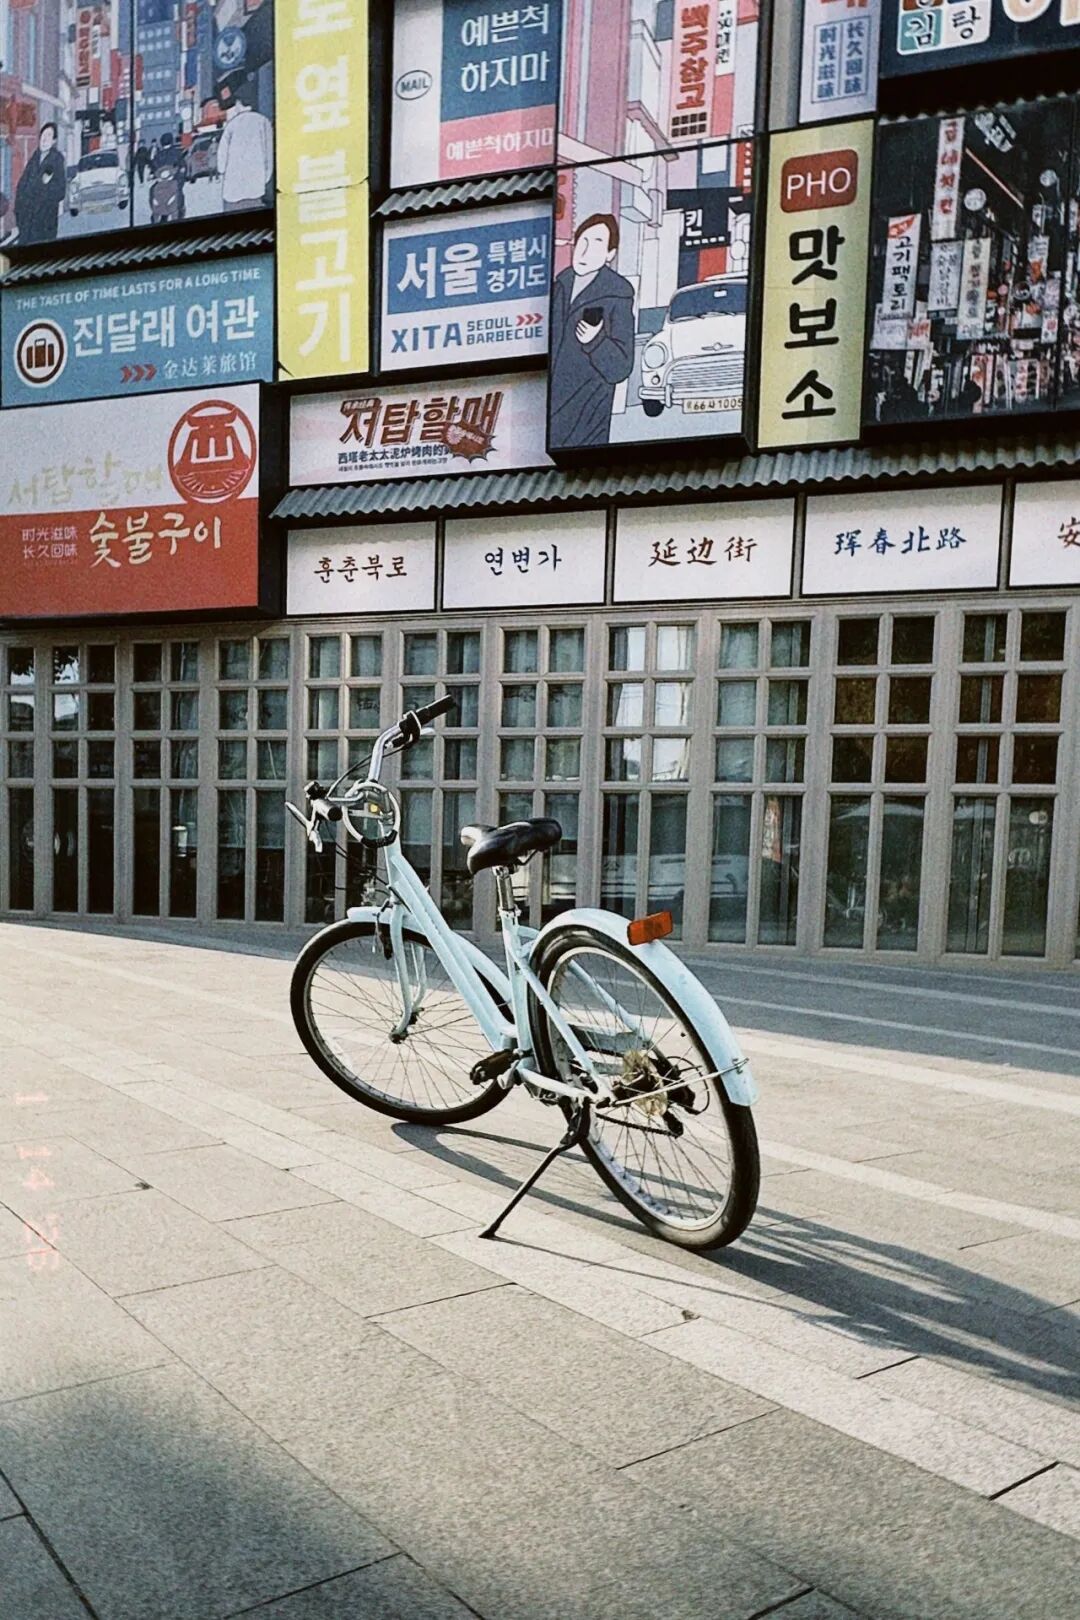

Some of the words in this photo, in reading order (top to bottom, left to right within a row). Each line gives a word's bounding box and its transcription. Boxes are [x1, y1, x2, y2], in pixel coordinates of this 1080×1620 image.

[461, 3, 549, 47] 예쁜척
[400, 78, 429, 92] MAIL
[460, 51, 550, 93] 하지마
[786, 166, 851, 200] PHO
[487, 235, 547, 264] 특별시
[396, 242, 482, 299] 서울
[487, 264, 547, 293] 경기도
[17, 297, 38, 310] THE
[40, 292, 72, 306] TASTE
[74, 290, 89, 302] OF
[93, 286, 119, 299] TIME
[122, 281, 156, 297] LASTS
[159, 278, 182, 291] FOR
[184, 276, 193, 288] A
[195, 271, 228, 287] LONG
[230, 268, 261, 282] TIME
[72, 304, 176, 358] 진달래
[186, 295, 260, 344] 여관
[391, 322, 462, 353] XITA
[466, 326, 543, 346] BARBECUE
[467, 316, 513, 332] SEOUL
[781, 225, 846, 420] 맛보소
[23, 544, 78, 559] 长久回味
[89, 511, 221, 569] 숯불구이
[648, 535, 759, 568] 延边街
[834, 525, 966, 556] 珲春北路
[313, 554, 408, 583] 훈춘북로
[484, 544, 562, 576] 연변가
